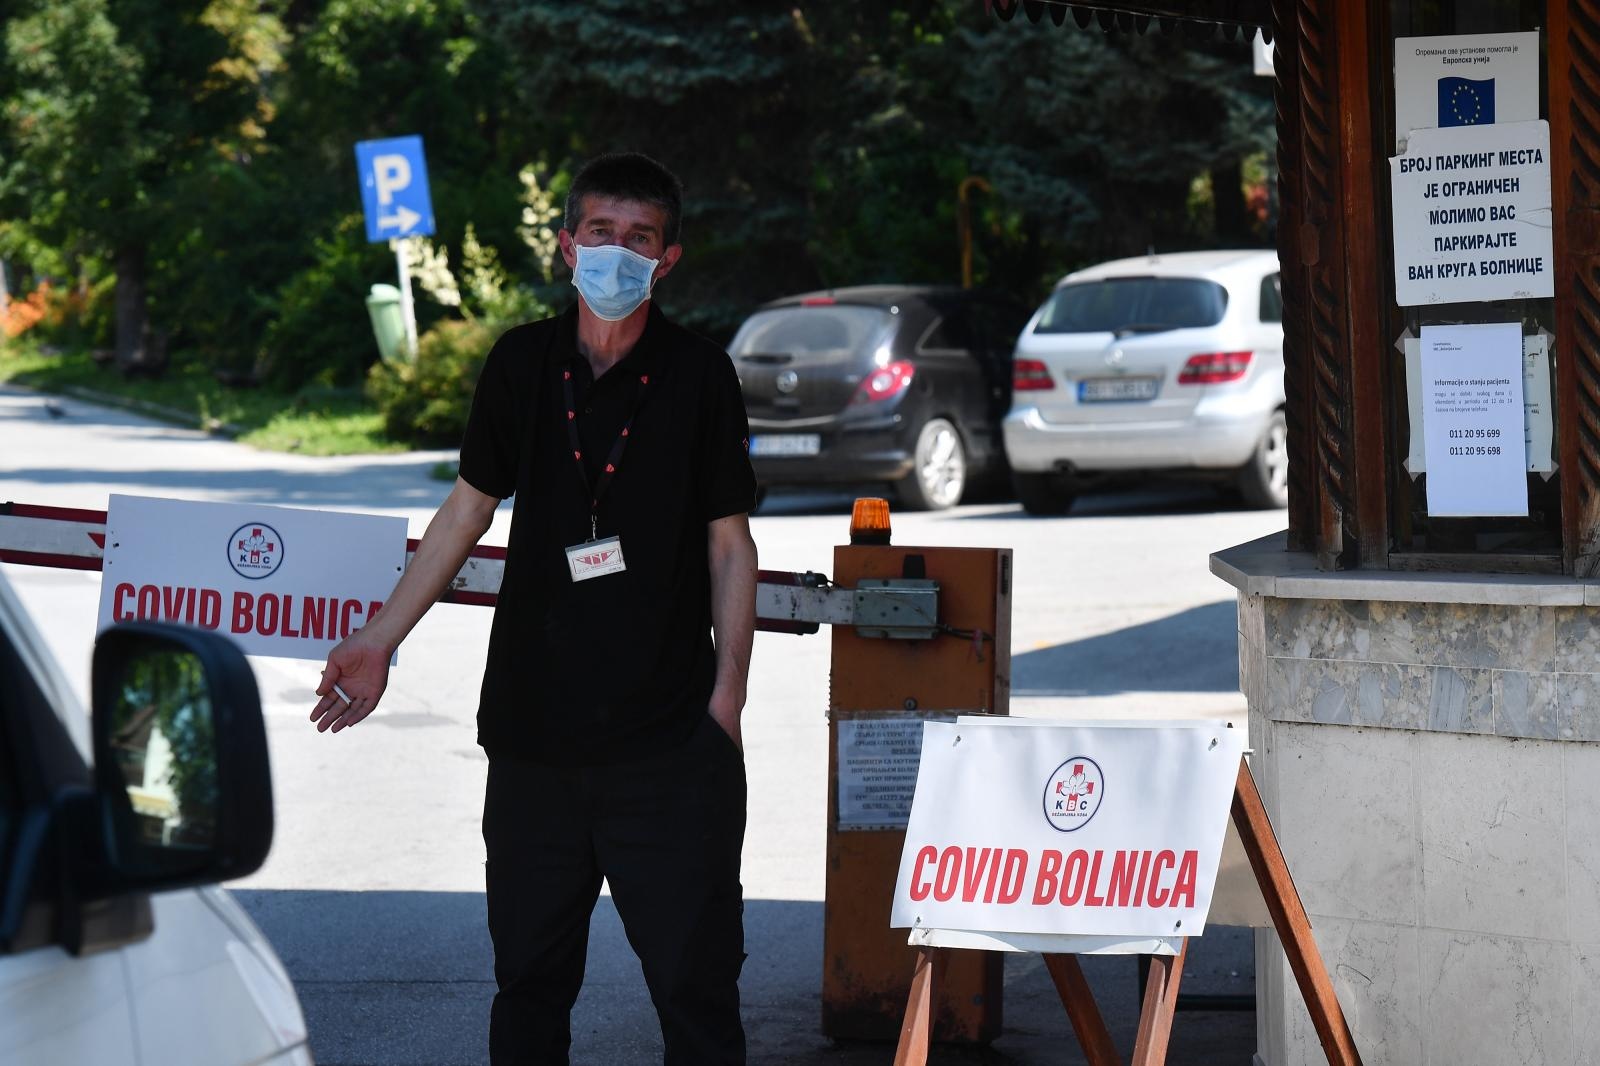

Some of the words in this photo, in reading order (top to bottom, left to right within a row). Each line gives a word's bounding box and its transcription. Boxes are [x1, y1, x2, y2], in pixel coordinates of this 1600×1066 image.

[1443, 57, 1472, 65] Европска
[1473, 56, 1490, 64] унија
[1399, 157, 1432, 173] БРОЈ
[1435, 152, 1496, 171] ПАРКИНГ
[1498, 148, 1543, 167] МЕСТА
[373, 154, 412, 205] P
[1423, 183, 1439, 198] ЈЕ
[1442, 177, 1520, 197] ОГРАНИЧЕН
[1429, 207, 1486, 225] МОЛИМО
[1489, 204, 1516, 221] ВАС
[1434, 231, 1518, 252] ПАРКИРАЈТЕ
[1408, 264, 1434, 280] ВАН
[1437, 260, 1477, 279] КРУГА
[1480, 257, 1544, 276] БОЛНИЦЕ
[1487, 378, 1510, 386] pacijenta
[1450, 430, 1463, 438] 011
[1465, 430, 1474, 438] 20
[1476, 429, 1485, 438] 95
[1487, 429, 1501, 438] 699
[1450, 447, 1464, 455] 011
[1466, 447, 1475, 455] 20
[1477, 447, 1486, 455] 95
[1488, 447, 1501, 455] 698
[112, 582, 223, 631] COVID
[909, 845, 1028, 905] COVID
[1032, 848, 1198, 908] BOLNICA
